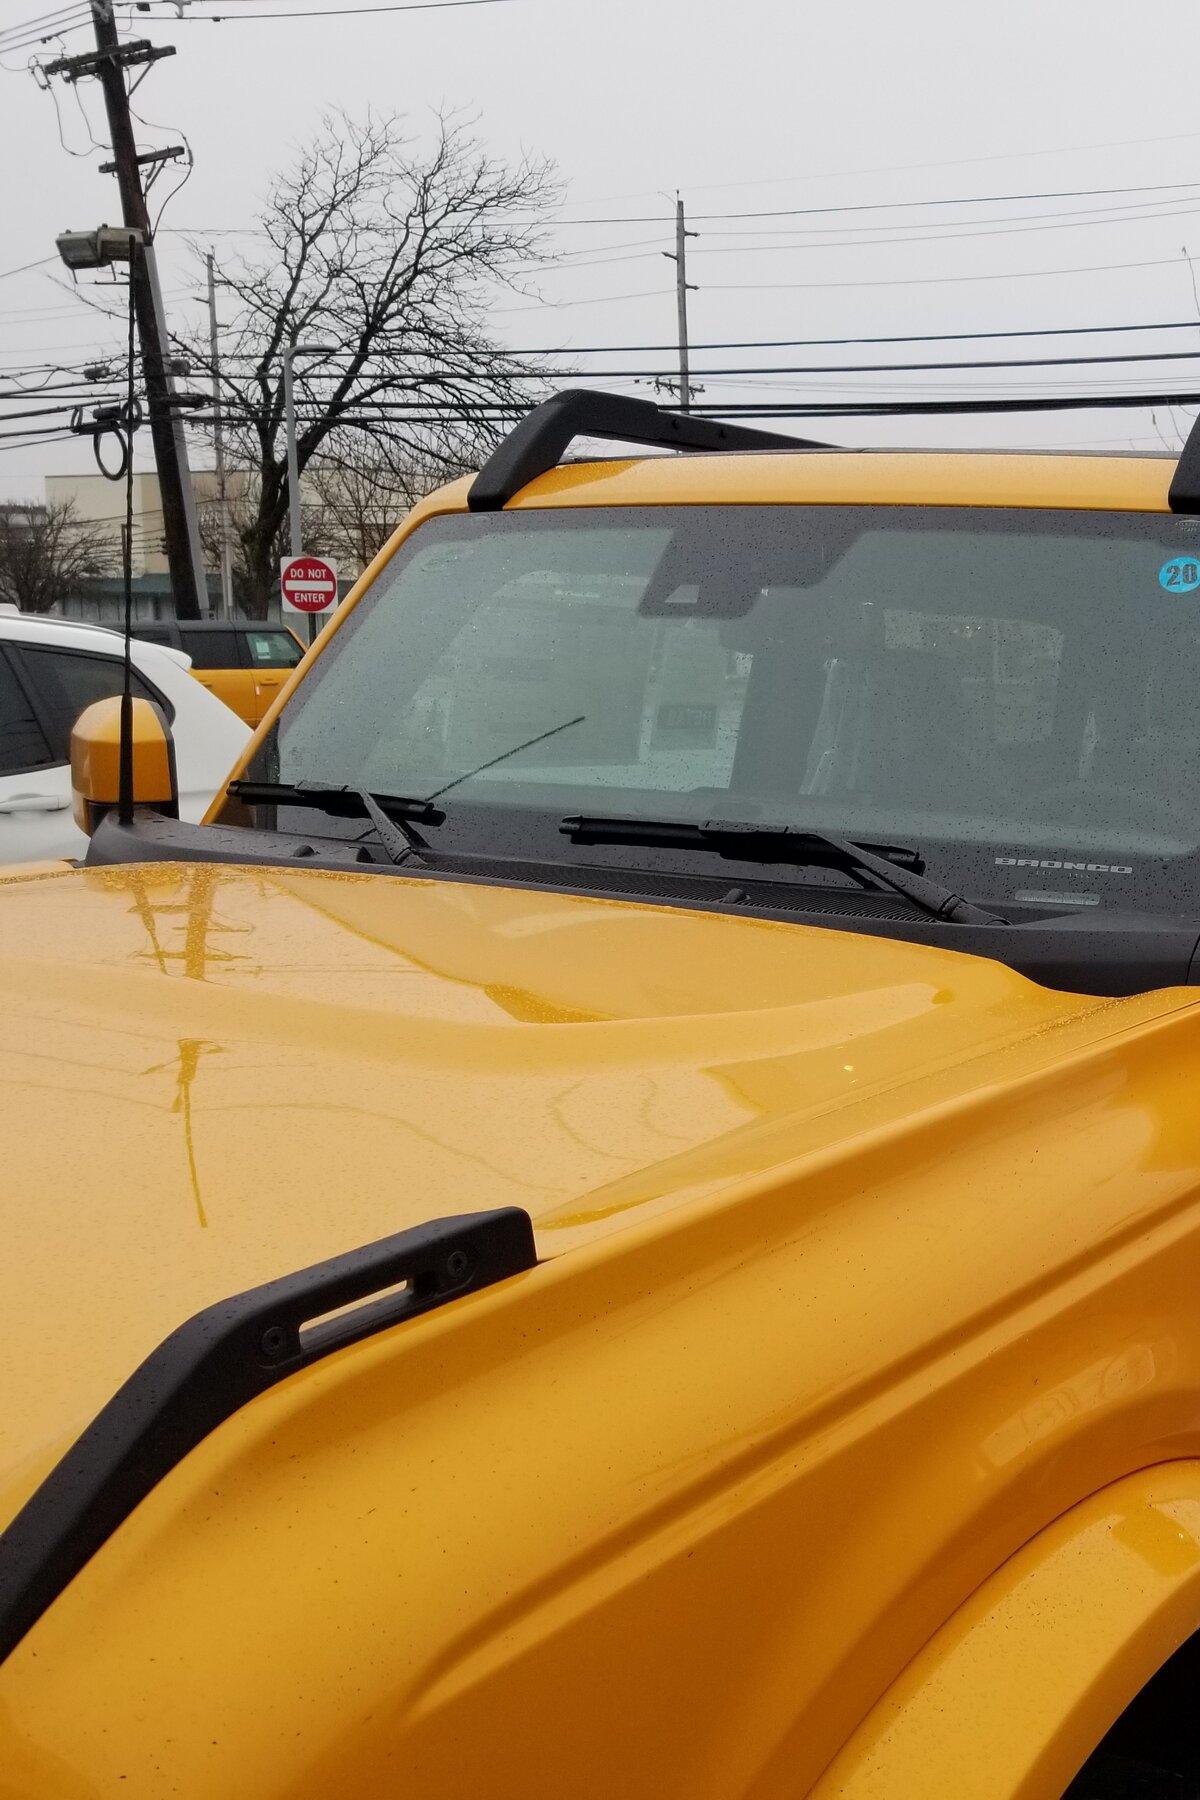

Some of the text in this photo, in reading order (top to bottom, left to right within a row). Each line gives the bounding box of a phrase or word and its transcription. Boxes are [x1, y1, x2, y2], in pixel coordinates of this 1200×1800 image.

[290, 568, 327, 580] DO NOT
[1166, 563, 1198, 587] 20
[294, 592, 326, 603] ENTER
[994, 857, 1133, 874] BRONCO
